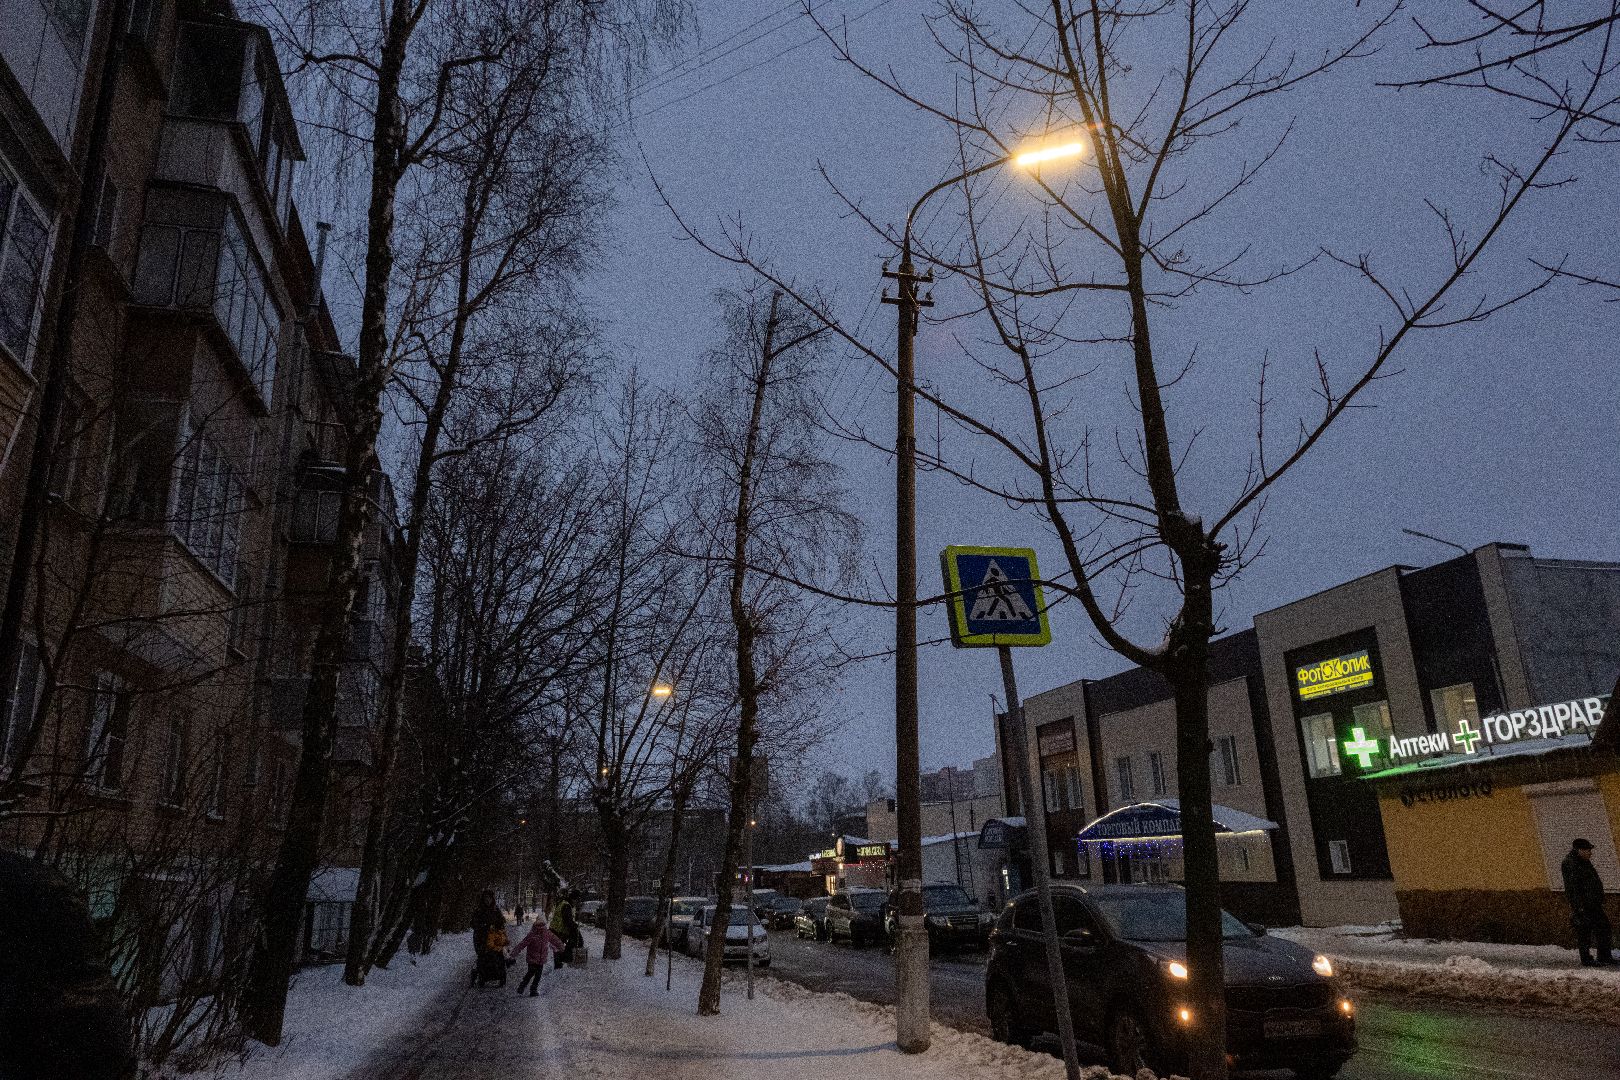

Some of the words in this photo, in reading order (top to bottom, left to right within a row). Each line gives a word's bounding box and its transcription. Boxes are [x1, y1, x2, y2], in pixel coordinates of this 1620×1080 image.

[1389, 732, 1450, 759] Аптеки
[1483, 697, 1605, 743] ГОРЗДРАВ
[1142, 817, 1182, 834] КОМПЛЕ
